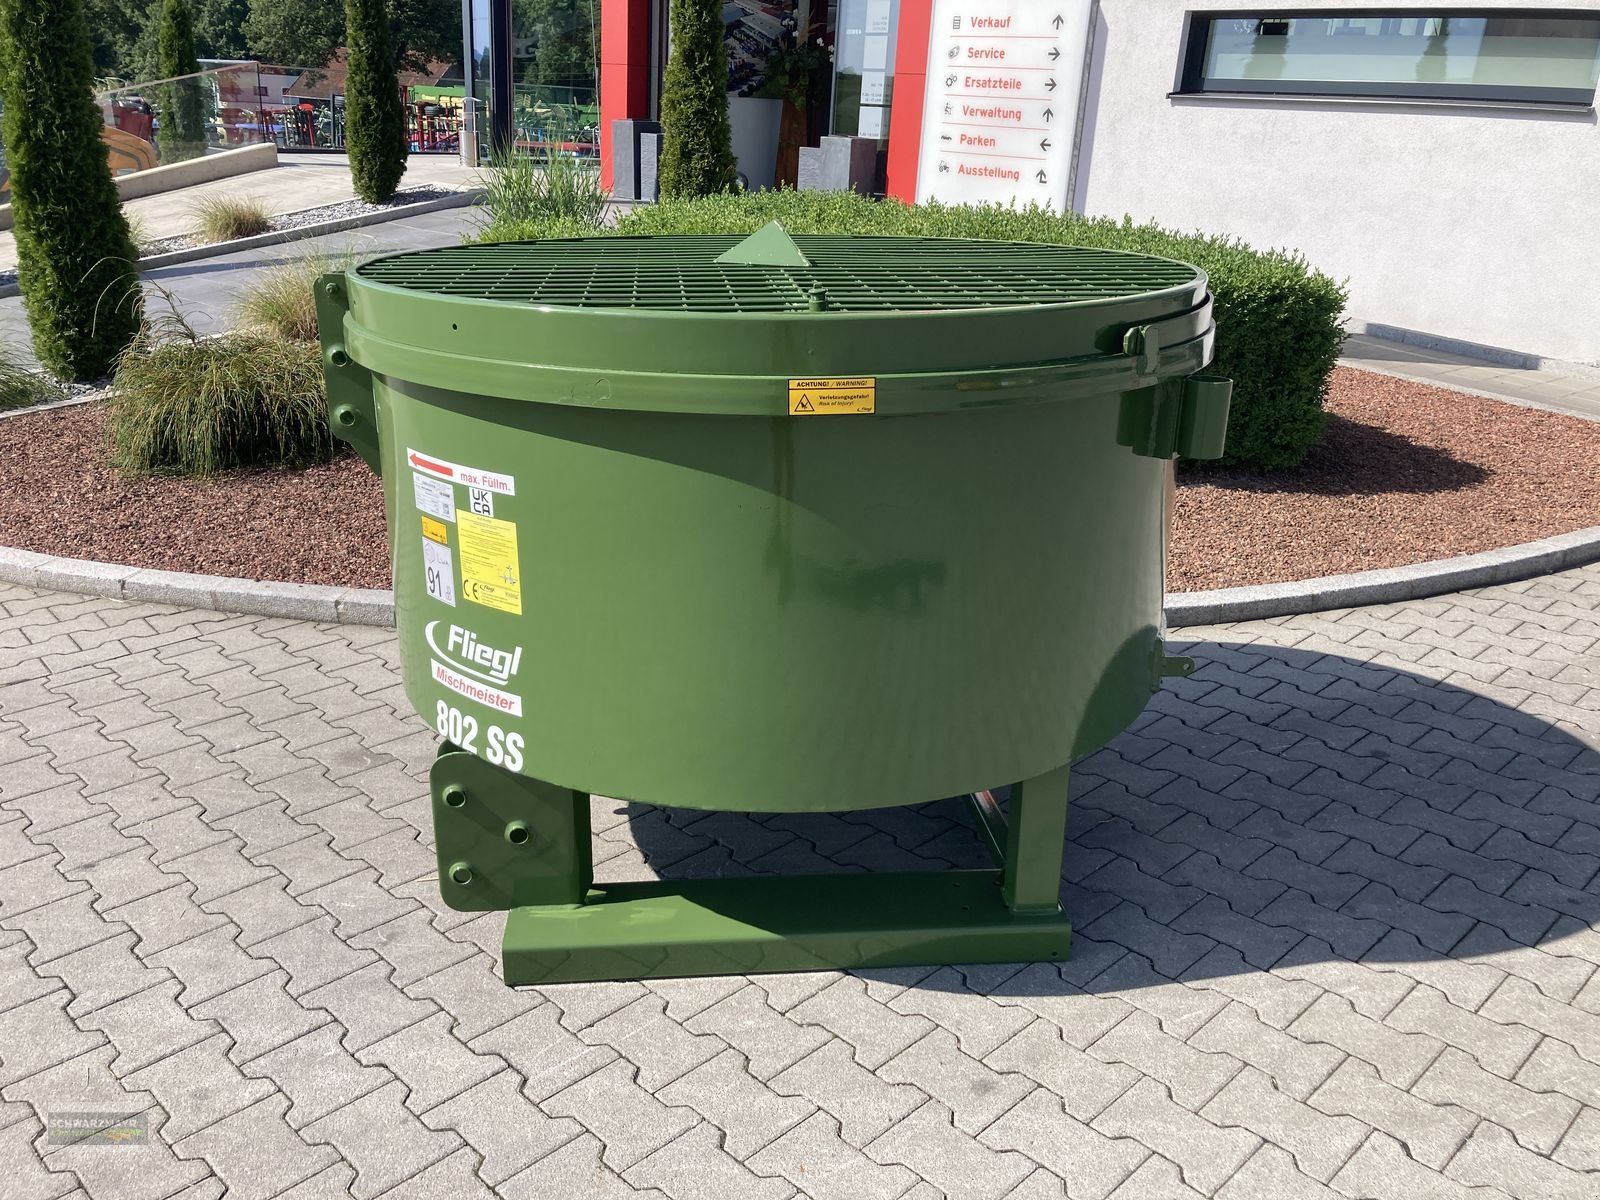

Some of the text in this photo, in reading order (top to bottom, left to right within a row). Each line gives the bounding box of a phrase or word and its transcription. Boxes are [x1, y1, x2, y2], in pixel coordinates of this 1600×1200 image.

[970, 16, 1012, 28] Verkauf
[967, 47, 1006, 59] Service
[964, 76, 1022, 90] Ersatzteile
[962, 105, 1022, 121] Verwaltung
[959, 134, 996, 147] Parken
[957, 164, 1020, 181] Ausstellung
[460, 472, 512, 492] max. Füllm.
[472, 488, 489, 503] UK
[473, 501, 491, 516] CA
[427, 566, 442, 598] 91
[447, 623, 523, 681] Fliegl
[436, 666, 516, 711] Mischmeister
[436, 699, 525, 772] 802 SS
